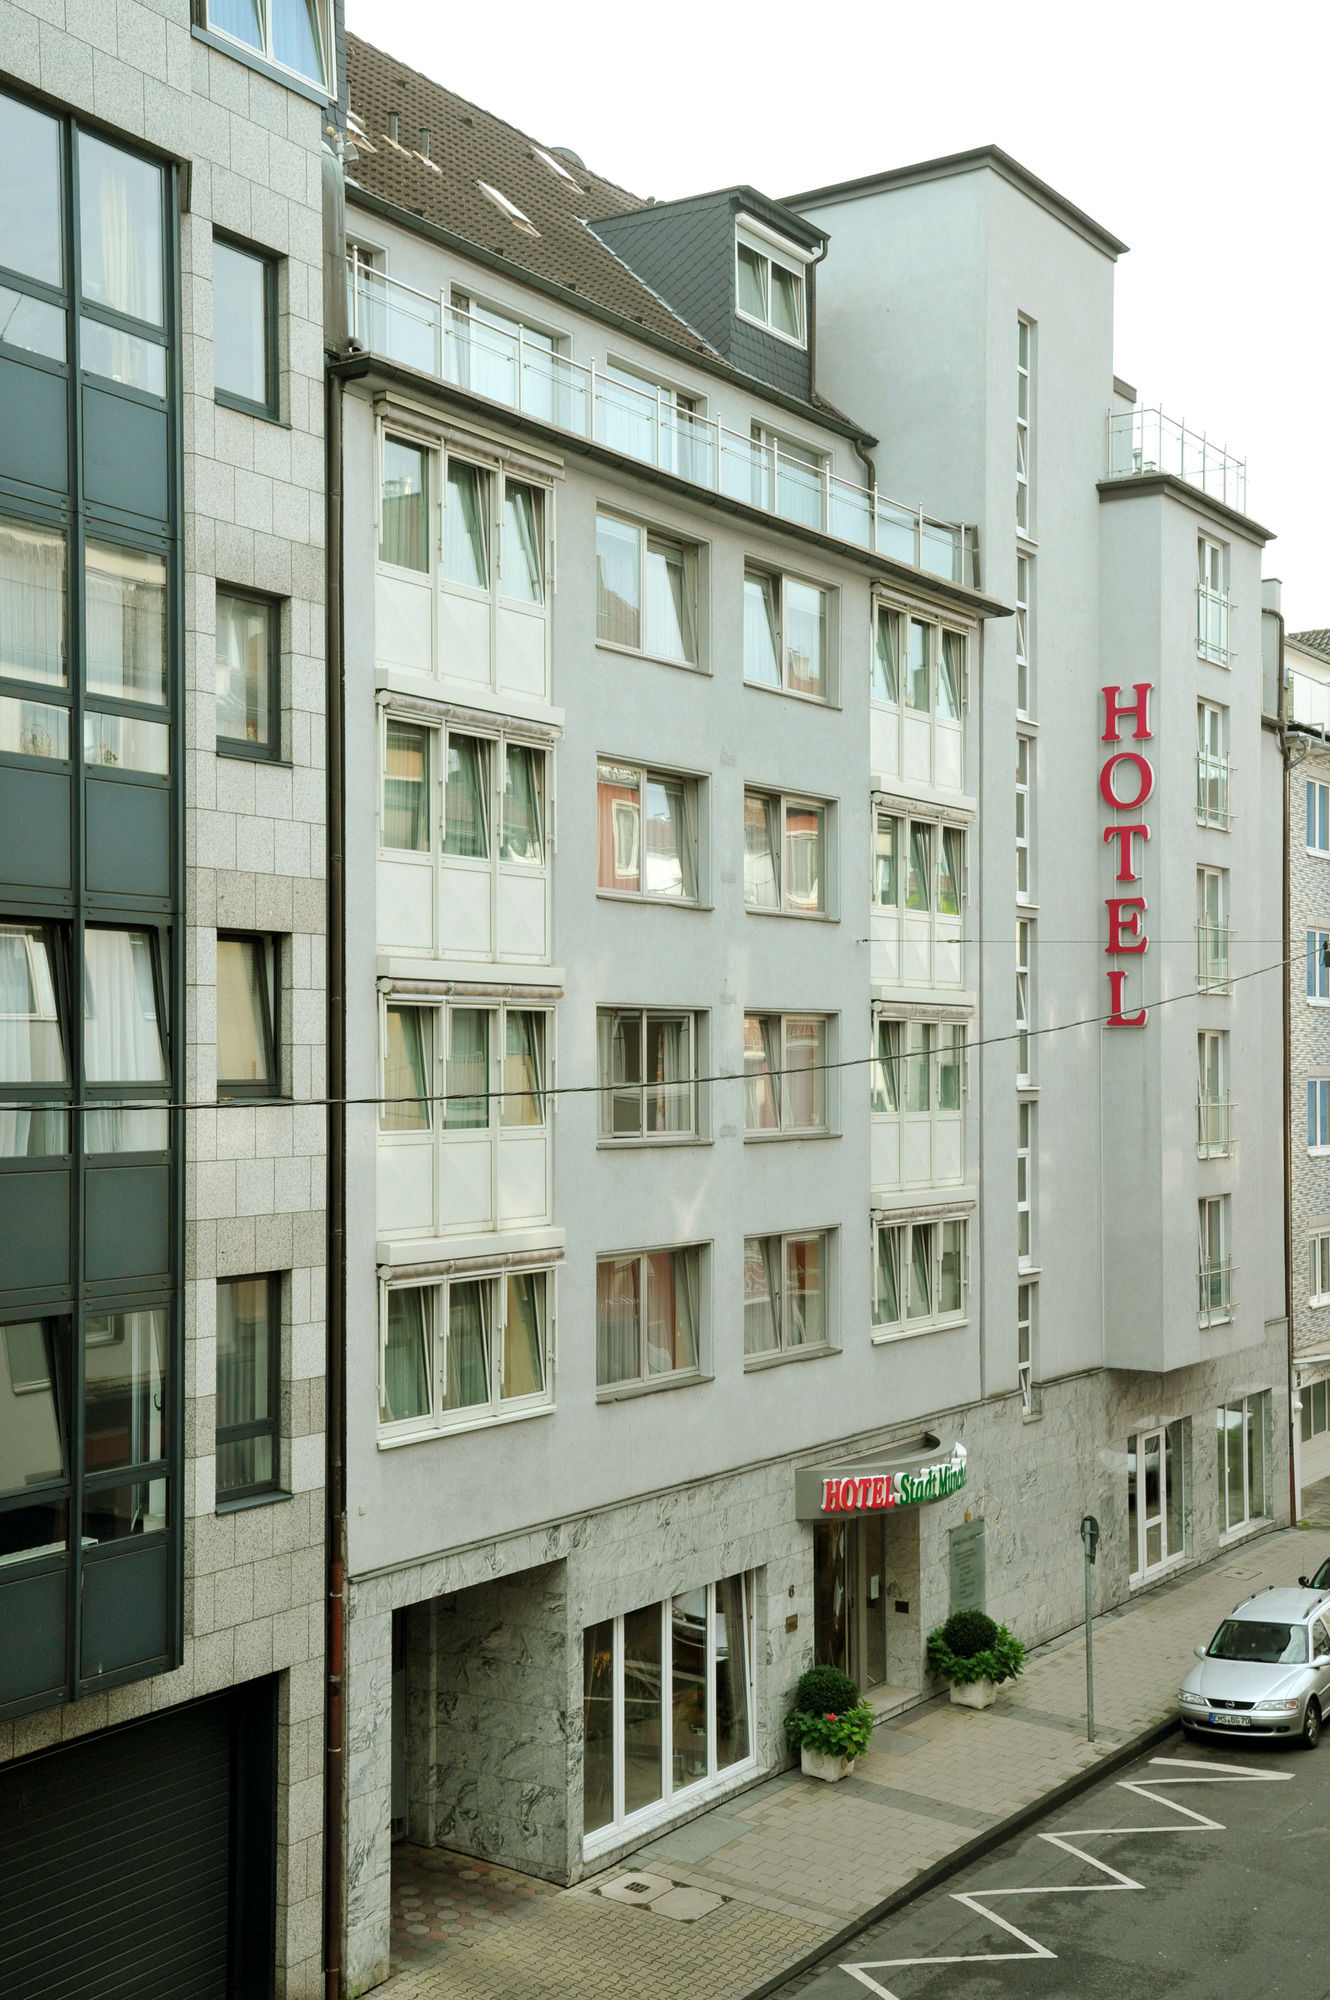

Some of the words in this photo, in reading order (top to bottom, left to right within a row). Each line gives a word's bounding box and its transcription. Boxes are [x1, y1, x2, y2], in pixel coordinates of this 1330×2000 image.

[1100, 683, 1153, 1026] HOTEL
[822, 1476, 895, 1512] HOTEL
[898, 1470, 937, 1505] Stadt
[788, 1584, 795, 1598] 6
